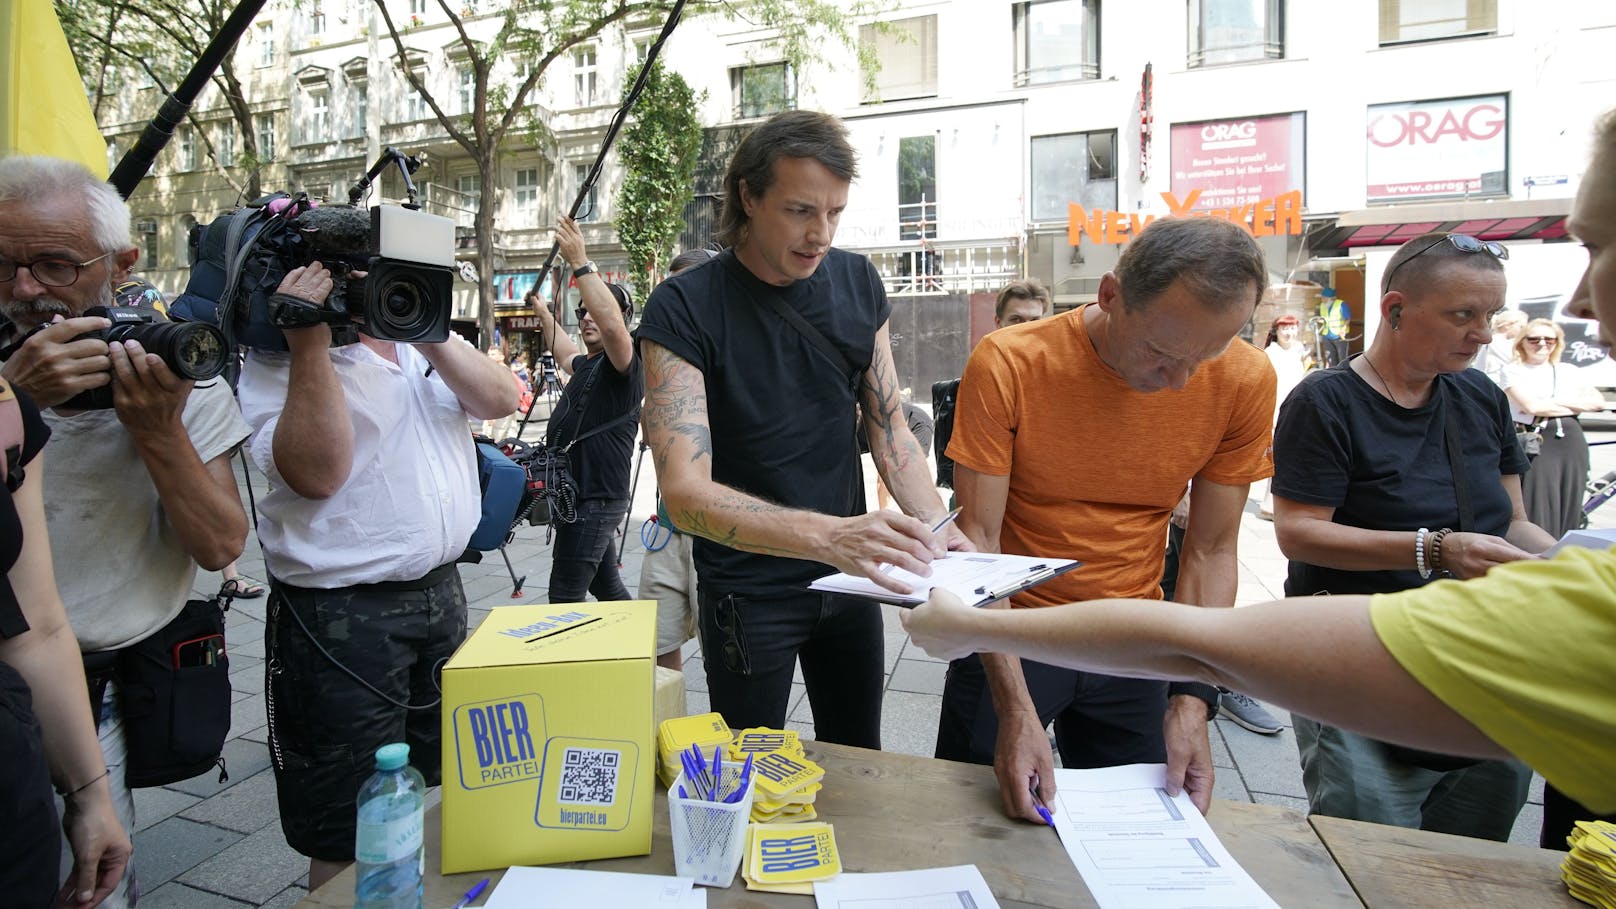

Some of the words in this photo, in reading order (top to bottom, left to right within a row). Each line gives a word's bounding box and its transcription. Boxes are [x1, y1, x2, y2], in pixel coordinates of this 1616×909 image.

[468, 701, 536, 768] BIER
[481, 761, 539, 783] PARTEI
[753, 753, 807, 783] BIER
[559, 808, 607, 827] bierpartei.eu
[761, 835, 820, 873] BIER
[816, 832, 833, 866] PARTEI
